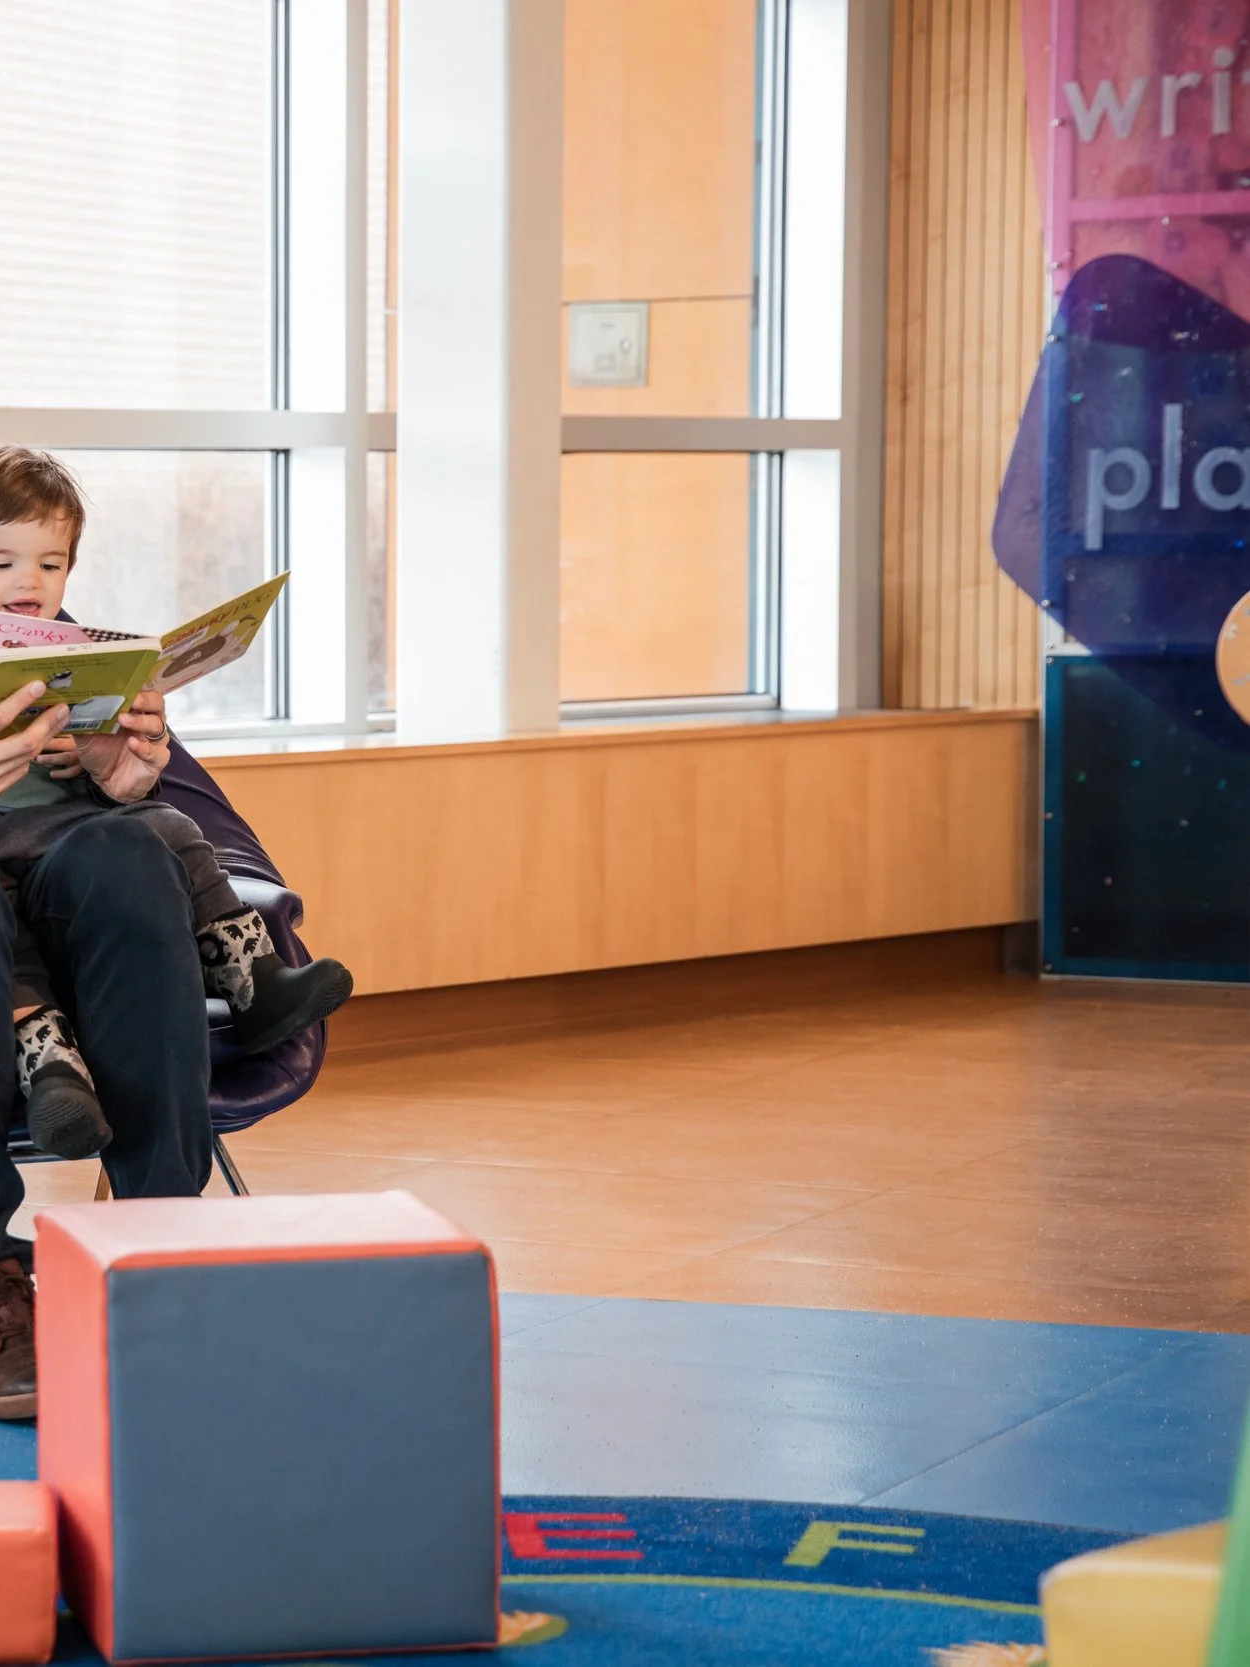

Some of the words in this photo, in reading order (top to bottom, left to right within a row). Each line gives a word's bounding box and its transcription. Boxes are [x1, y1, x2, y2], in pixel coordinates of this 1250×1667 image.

[1064, 47, 1250, 141] wri
[504, 1513, 644, 1559] E
[783, 1521, 926, 1567] F
